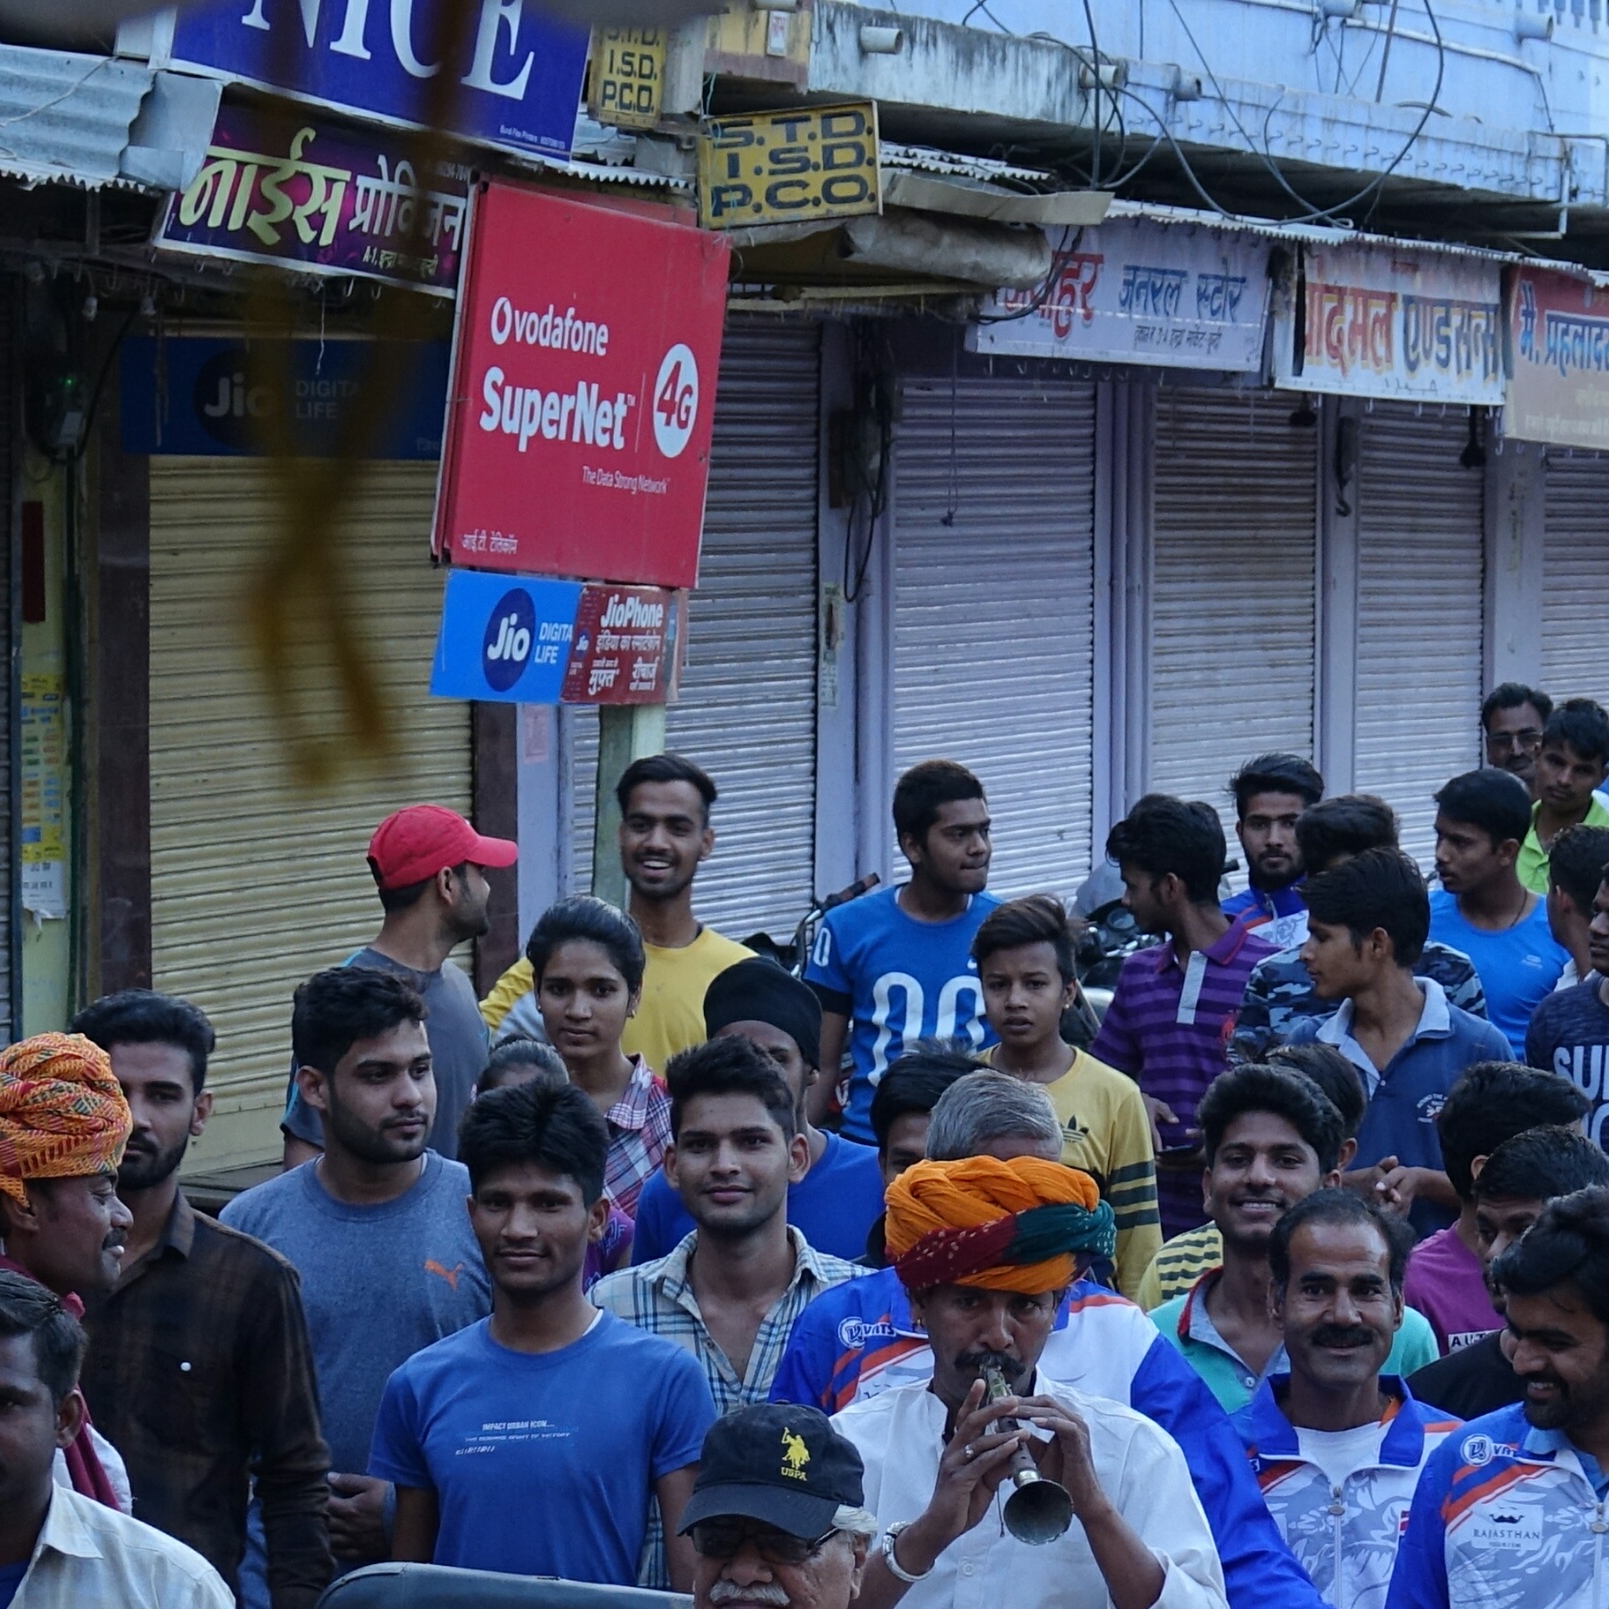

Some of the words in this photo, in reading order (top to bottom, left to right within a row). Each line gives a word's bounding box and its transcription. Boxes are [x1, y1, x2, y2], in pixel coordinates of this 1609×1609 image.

[601, 81, 655, 114] P.C.O.
[712, 110, 873, 149] S.T.D.
[727, 141, 875, 180] I.S.D.
[711, 174, 876, 218] P.C.O.
[514, 303, 610, 357] vodafone
[478, 365, 629, 453] SuperNet
[600, 593, 664, 628] JioPhone
[487, 612, 531, 662] Jio
[534, 645, 559, 664] LIFE
[1472, 1528, 1541, 1540] RAJASTHAN
